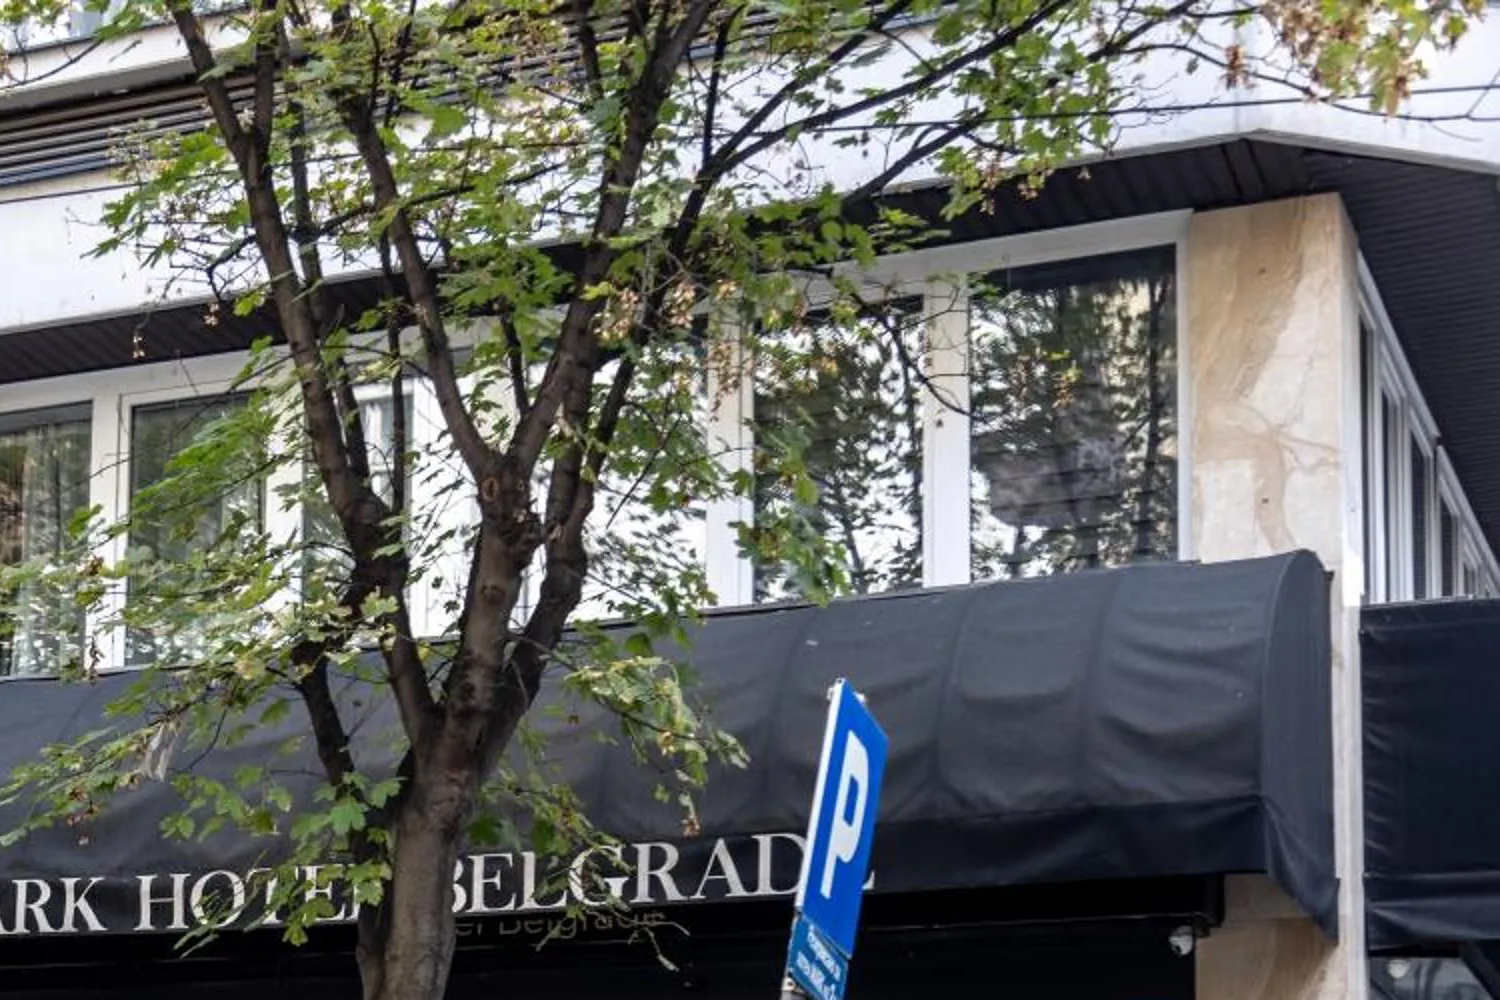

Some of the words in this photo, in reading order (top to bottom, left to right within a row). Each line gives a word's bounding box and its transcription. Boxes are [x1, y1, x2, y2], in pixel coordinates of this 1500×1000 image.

[133, 863, 364, 931] HOTE
[452, 832, 875, 914] ELGRAD
[820, 729, 869, 900] P
